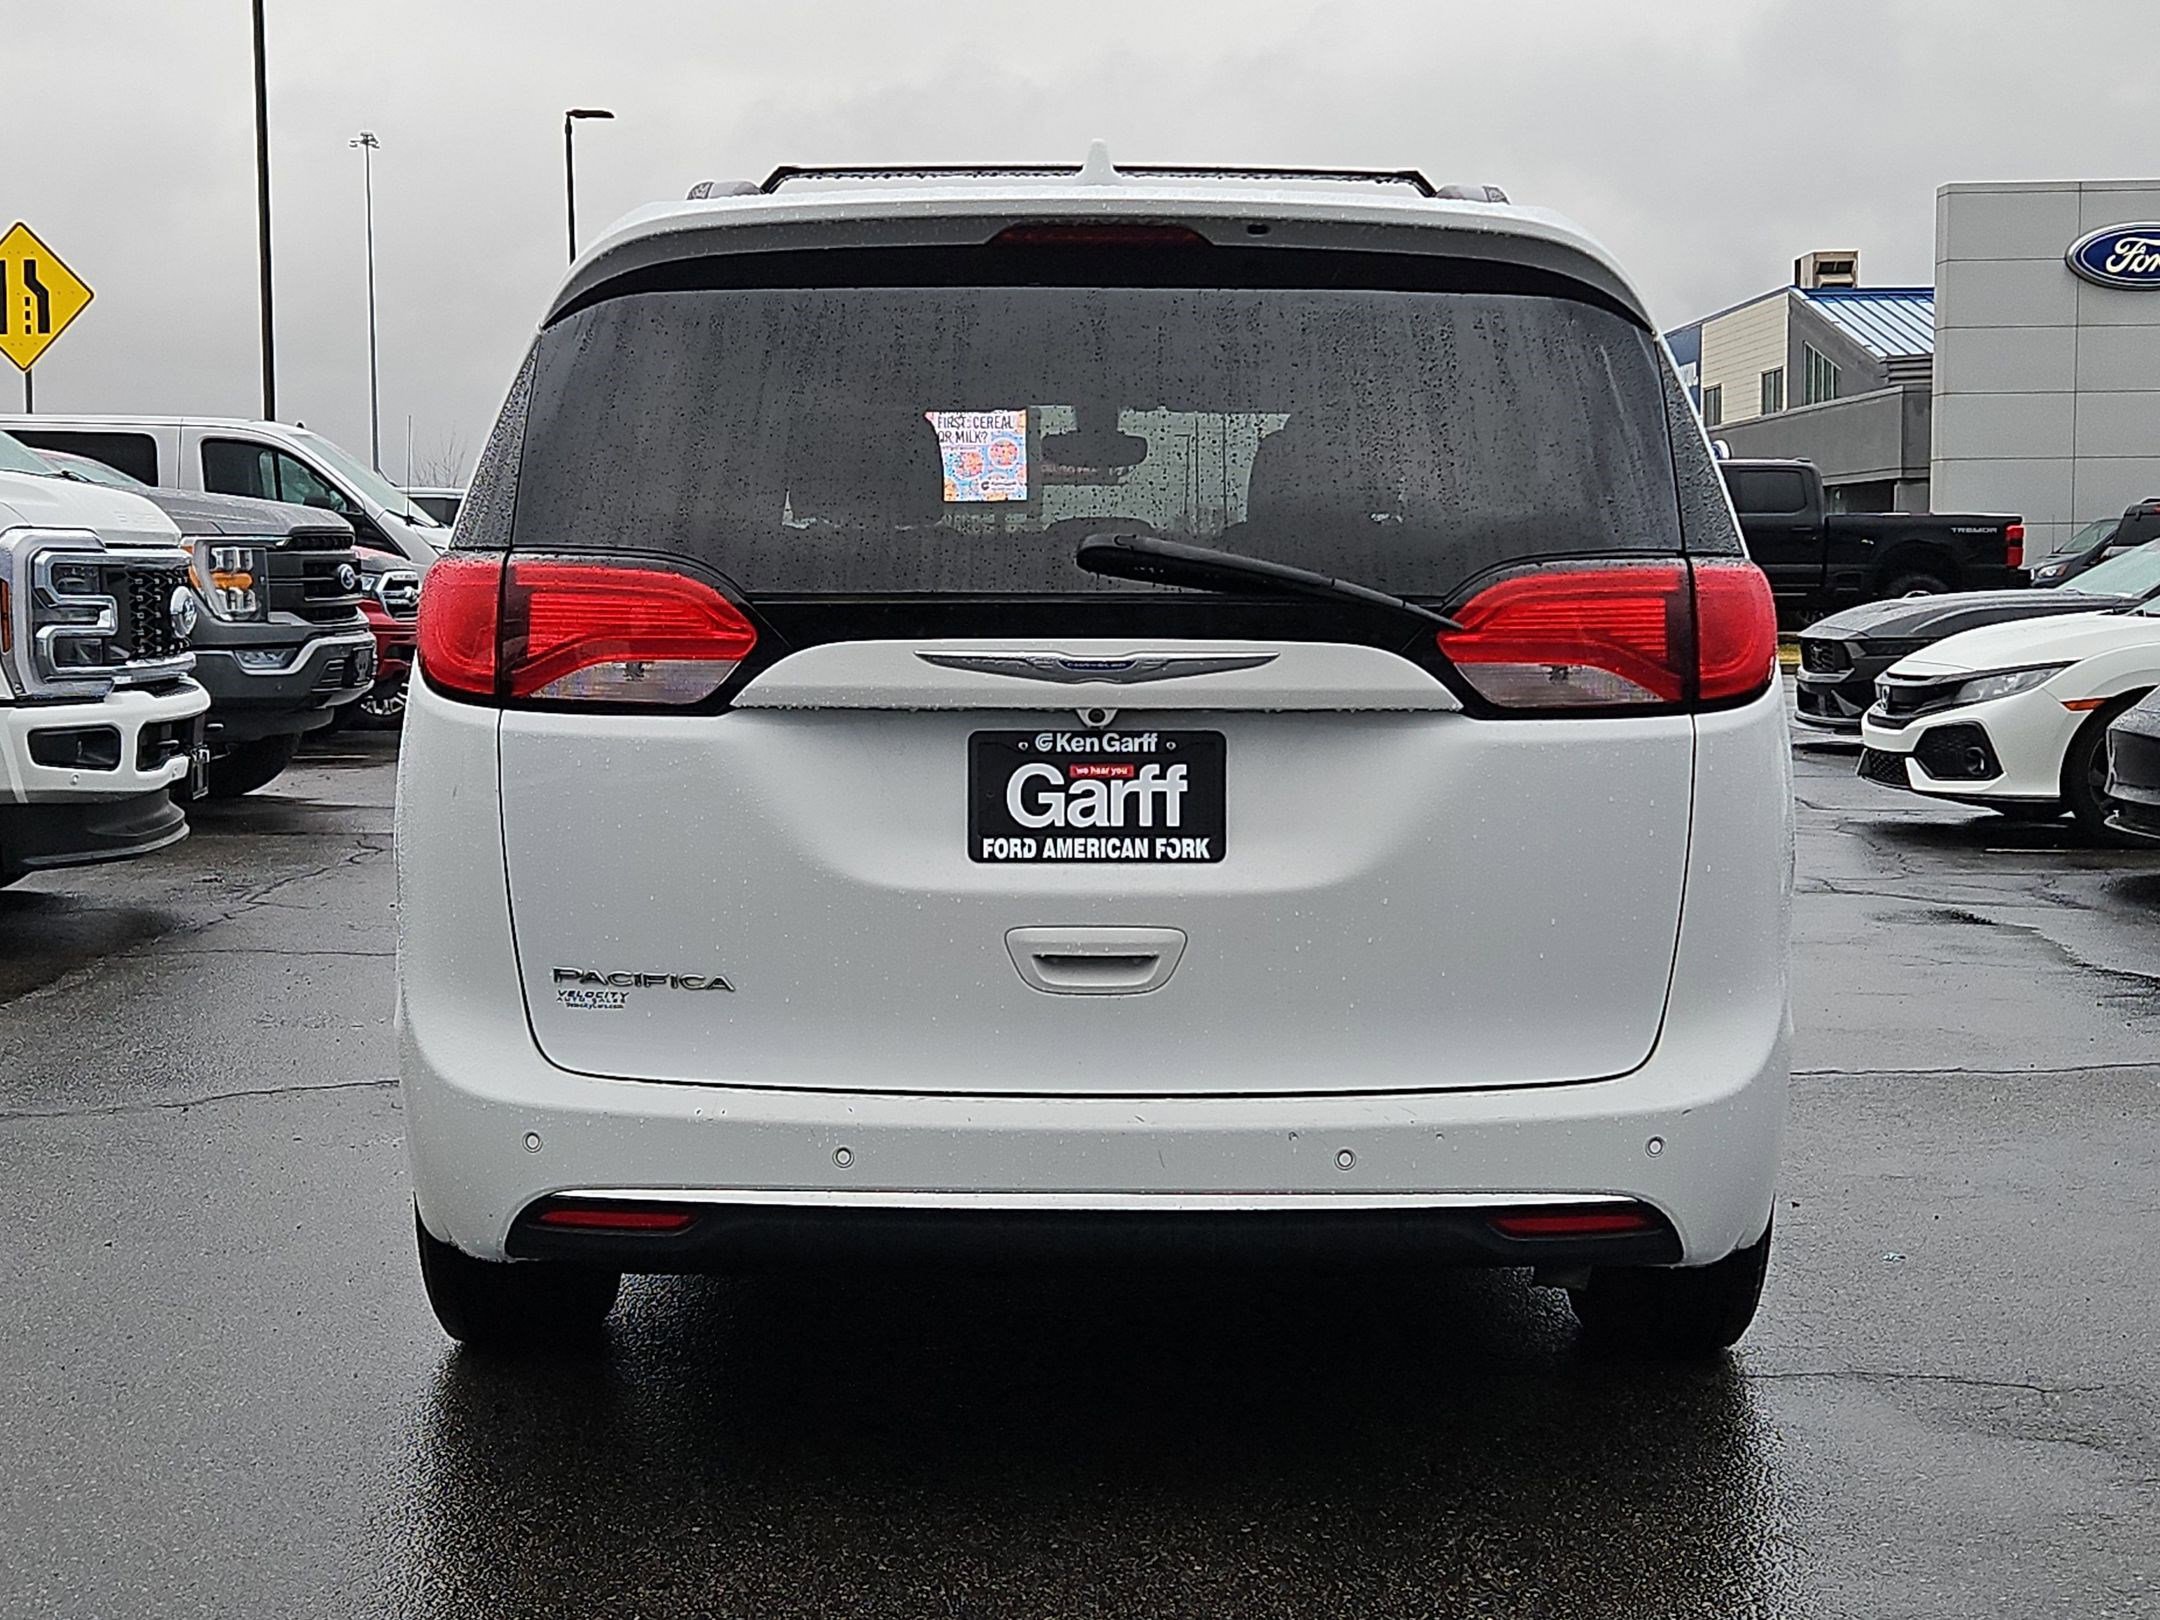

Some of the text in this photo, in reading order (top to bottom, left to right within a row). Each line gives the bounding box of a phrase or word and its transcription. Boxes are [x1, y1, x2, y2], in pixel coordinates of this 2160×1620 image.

[973, 415, 1014, 429] CEREAL
[938, 430, 988, 444] OR MILK?
[1056, 732, 1100, 752] Ken
[1102, 732, 1158, 752] Garff
[1111, 767, 1128, 776] you
[1006, 763, 1188, 828] Garff
[982, 838, 1210, 859] FORD AMERICAN FORK
[553, 966, 736, 992] PACIFICA
[557, 990, 630, 999] VELOCITY
